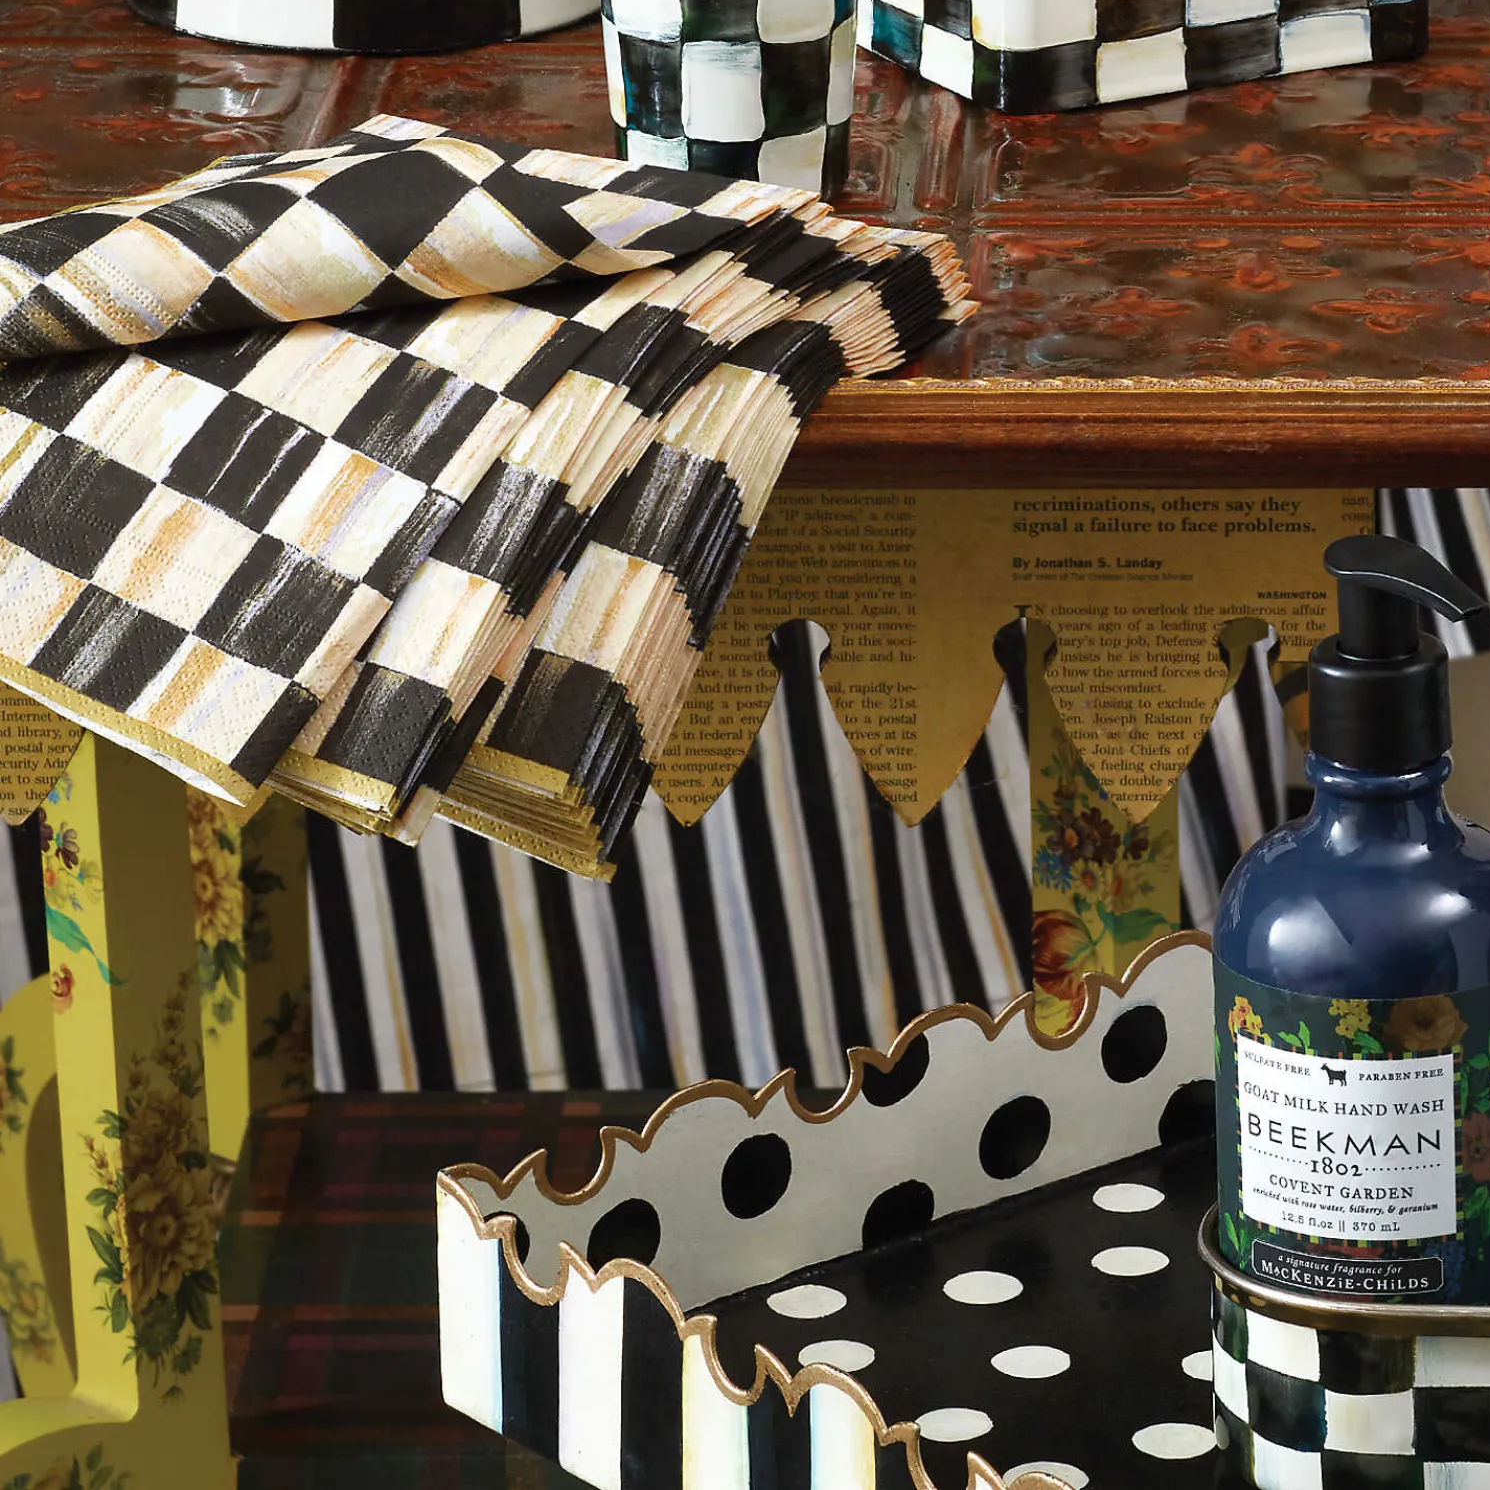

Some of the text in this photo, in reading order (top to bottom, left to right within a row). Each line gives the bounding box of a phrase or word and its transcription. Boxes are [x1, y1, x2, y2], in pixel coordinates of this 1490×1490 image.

[1013, 496, 1302, 516] recriminations, others say they
[1012, 517, 1316, 537] signal a failure to face problems.
[1012, 557, 1162, 571] By Jonathan S. Landay
[826, 572, 901, 586] considering
[1257, 591, 1327, 600] WASHINGTON
[1051, 604, 1326, 618] choosing to overlook the adulterous affair
[843, 622, 872, 632] your
[1057, 619, 1207, 633] years ago of leading
[1100, 635, 1207, 648] top job, Defense
[1146, 651, 1200, 665] bringing
[1063, 666, 1200, 678] how the armed forces
[695, 682, 750, 693] And then
[849, 681, 893, 695] rapidly
[1089, 682, 1166, 693] misconduct.
[890, 698, 917, 709] 21st
[1157, 697, 1205, 709] exclude
[689, 713, 711, 724] But
[878, 713, 917, 726] postal
[1092, 713, 1192, 726] Joseph Ralston
[18, 725, 62, 739] library,
[699, 729, 742, 740] federal
[1129, 728, 1184, 740] the next
[5, 741, 43, 755] postal
[1091, 743, 1191, 756] Joint Chiefs of
[1101, 759, 1144, 773] fueling
[668, 777, 705, 788] users.
[1119, 774, 1163, 786] double
[1285, 1064, 1310, 1076] FREE
[1358, 1069, 1444, 1081] PARABEN FREE
[1243, 1082, 1444, 1117] GOAT MILK HAND WASH
[1248, 1113, 1441, 1156] BEEKMAN
[1310, 1158, 1362, 1177] 1802
[1270, 1174, 1414, 1199] COVENT GARDEN
[1282, 1194, 1299, 1206] with
[1301, 1200, 1317, 1209] rose
[1320, 1202, 1345, 1213] water,
[1349, 1203, 1384, 1216] bilberry,
[1388, 1205, 1396, 1214] &
[1399, 1202, 1438, 1215] geranium
[1308, 1217, 1333, 1229] fl.oz
[1353, 1220, 1377, 1232] 370
[1380, 1220, 1400, 1232] mL
[1286, 1255, 1329, 1274] signature
[1332, 1264, 1385, 1276] fragrance
[1387, 1265, 1402, 1276] for
